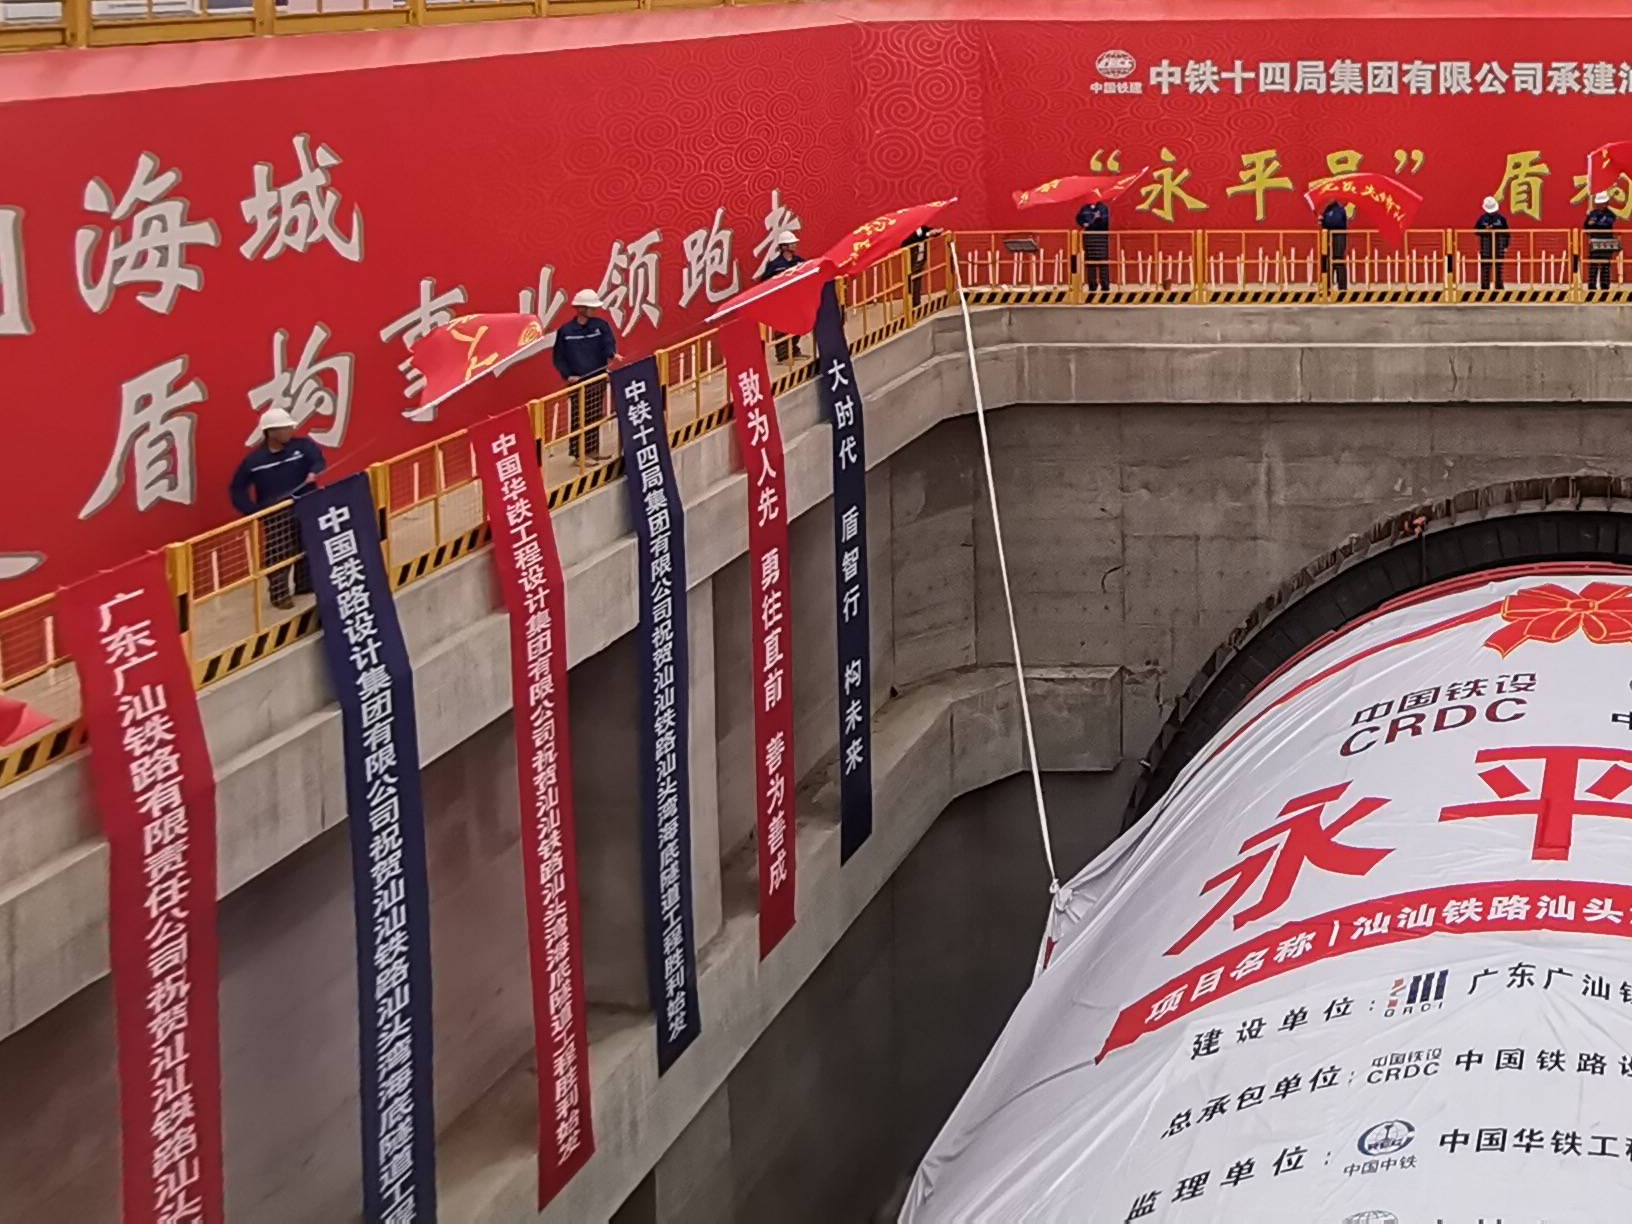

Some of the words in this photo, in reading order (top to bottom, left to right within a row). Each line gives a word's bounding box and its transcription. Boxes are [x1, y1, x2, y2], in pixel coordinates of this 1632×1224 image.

[737, 370, 779, 527] 敢为人先
[828, 357, 859, 471] 大时代
[841, 505, 860, 624] 盾智行
[760, 547, 785, 712] 勇往直前
[844, 659, 865, 776] 构未来
[1339, 698, 1526, 756] CRDC
[1351, 673, 1537, 726] 中国铁设
[764, 731, 788, 896] 善为善成
[99, 589, 202, 1224] 广东广汕铁路有限责任公司祝贺汕汕铁路汕头
[1367, 1062, 1440, 1084] CRDC
[1343, 1156, 1417, 1178] 中国中铁
